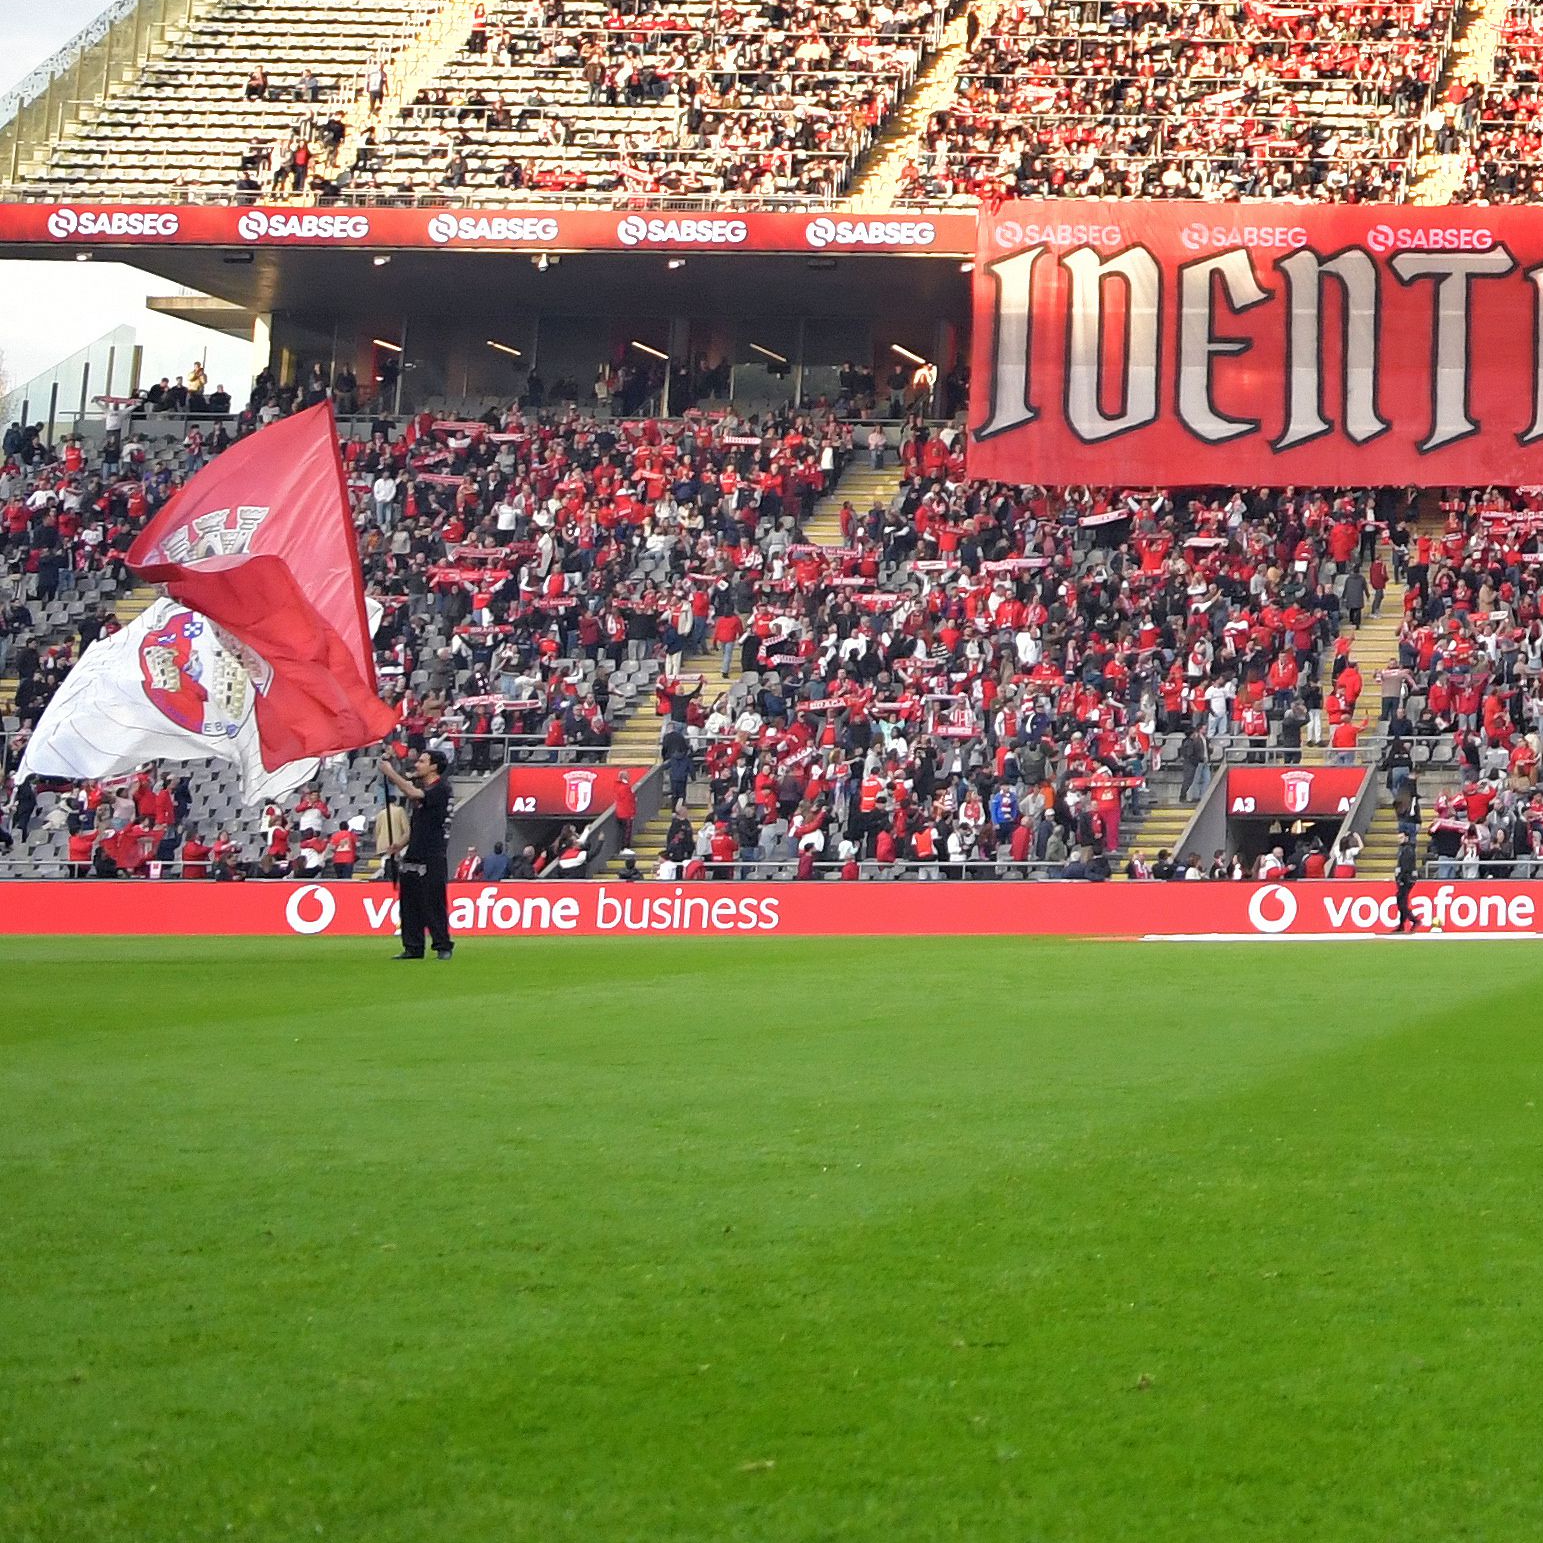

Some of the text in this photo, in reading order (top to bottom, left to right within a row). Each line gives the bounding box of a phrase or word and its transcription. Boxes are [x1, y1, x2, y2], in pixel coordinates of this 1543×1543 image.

[77, 213, 179, 237] SABSEG
[268, 215, 370, 239] SABSEG
[457, 217, 559, 242] SABSEG
[646, 219, 749, 244] SABSEG
[835, 221, 936, 246] SABSEG
[1211, 225, 1308, 249] SABSEG
[1396, 227, 1493, 251] SABSEG
[512, 796, 537, 812] A2
[1231, 796, 1256, 813] A3
[363, 887, 780, 930] vafone business
